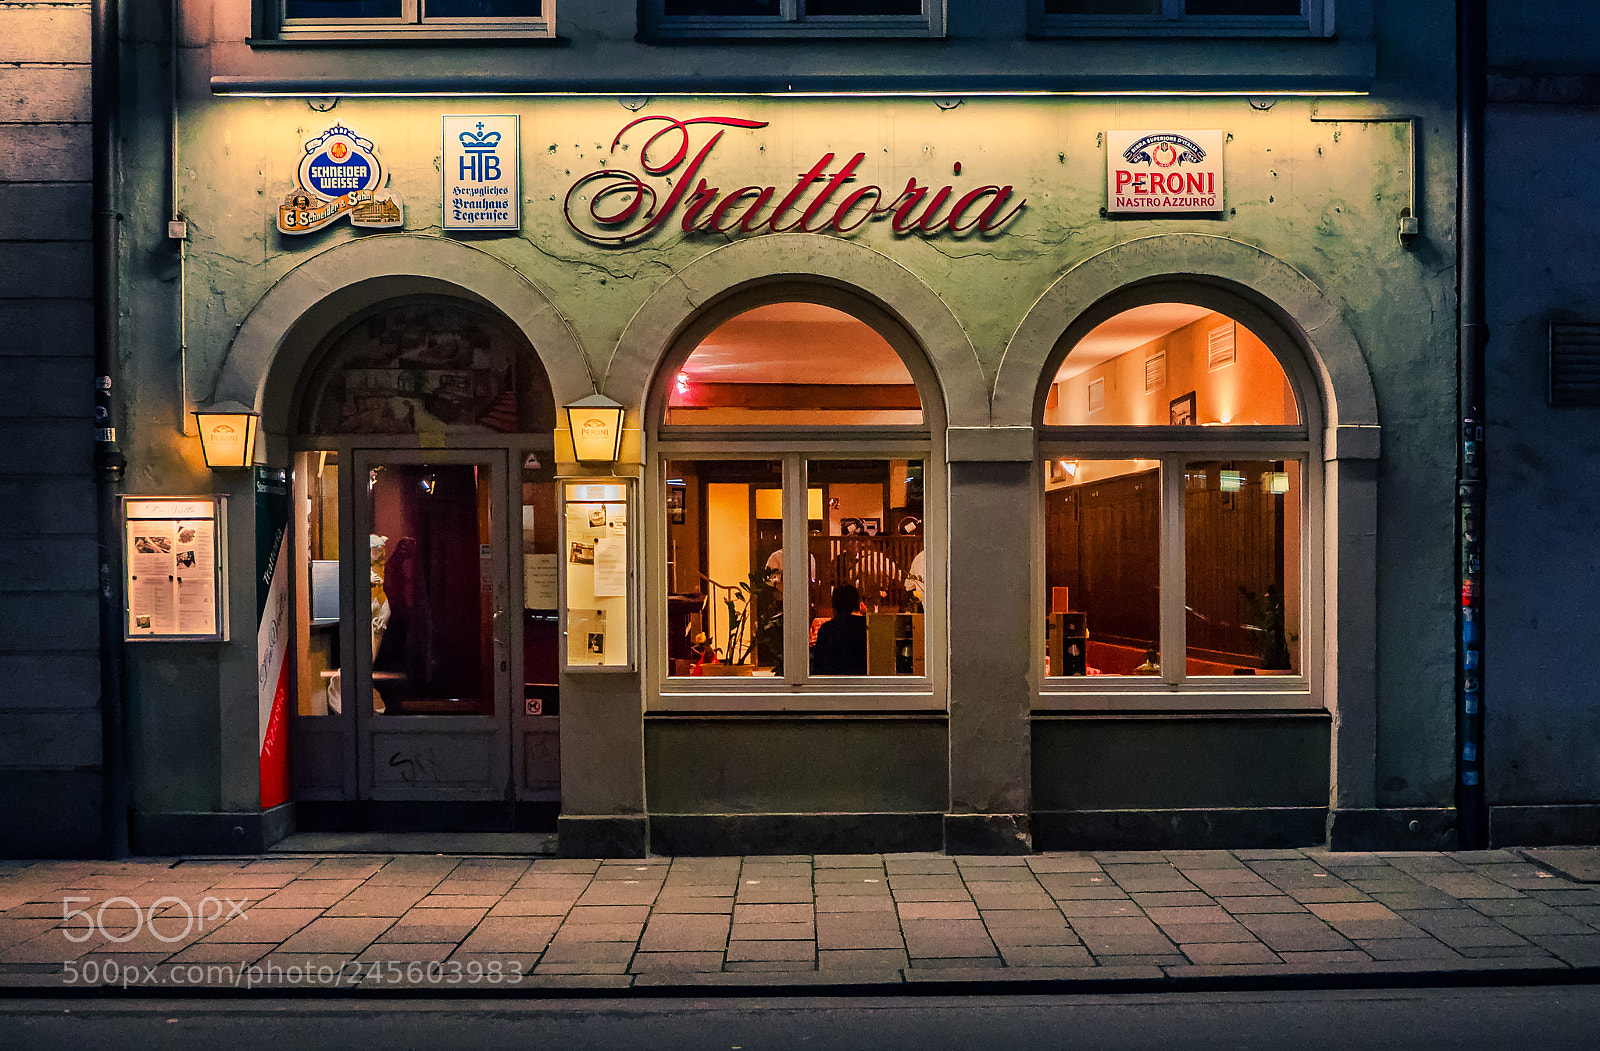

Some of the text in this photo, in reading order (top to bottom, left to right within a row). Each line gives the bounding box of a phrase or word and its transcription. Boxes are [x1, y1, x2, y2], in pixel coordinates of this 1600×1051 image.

[1131, 136, 1198, 153] BIRRA SUPERIORE D'ITALIA
[311, 166, 368, 178] SCHNEIDER
[459, 150, 502, 183] HTB
[320, 177, 359, 189] WEISSE
[564, 115, 1027, 244] Trattoria
[1115, 170, 1216, 195] PERONI
[452, 186, 509, 198] Herzogliches
[452, 198, 509, 211] Brauhaus
[1116, 196, 1215, 207] NASTRO AZZURRO
[298, 203, 340, 227] Schneider
[340, 199, 347, 208] &
[347, 191, 372, 206] Sohn
[453, 209, 509, 224] Tegernsee
[581, 428, 609, 436] PERONI
